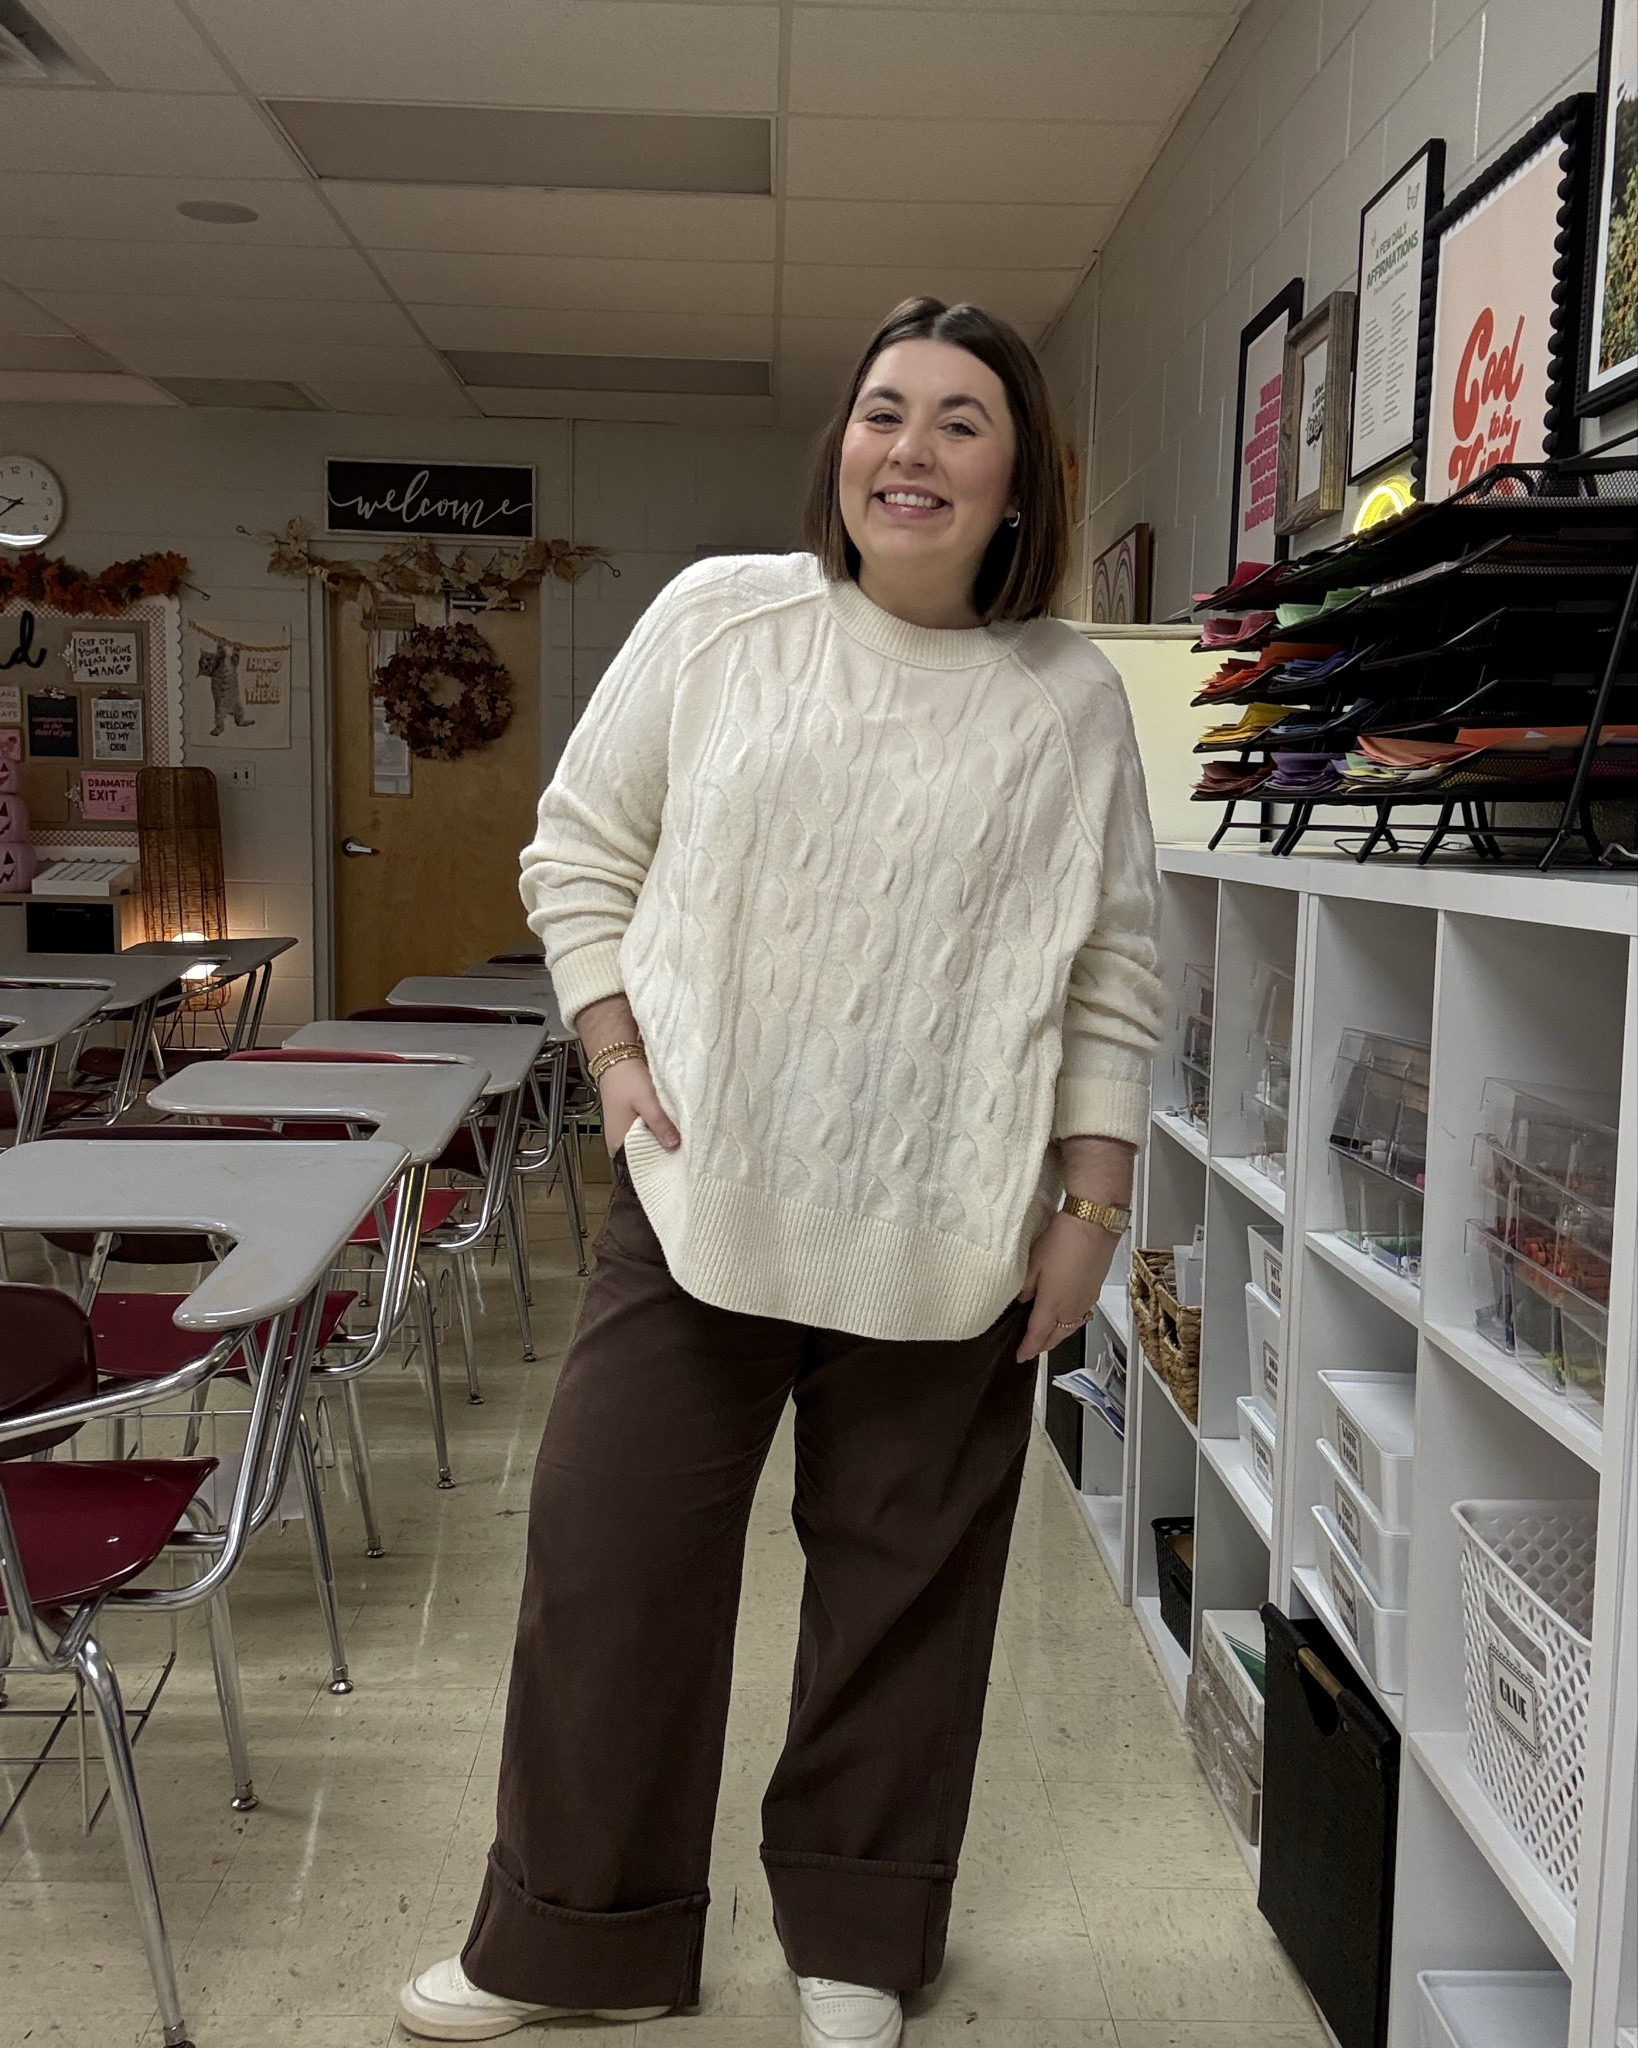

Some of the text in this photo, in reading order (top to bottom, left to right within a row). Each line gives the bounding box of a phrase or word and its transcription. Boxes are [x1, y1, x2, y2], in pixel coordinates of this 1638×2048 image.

[1366, 229, 1419, 290] AFFIRMATIONS
[1453, 307, 1525, 441] Cool
[1488, 411, 1500, 442] to
[328, 470, 532, 528] welcome
[96, 710, 137, 719] HELLO MTV
[100, 721, 135, 730] WELCOME
[106, 732, 116, 740] TO
[88, 778, 137, 788] DRAMATIC
[89, 790, 118, 801] EXIT
